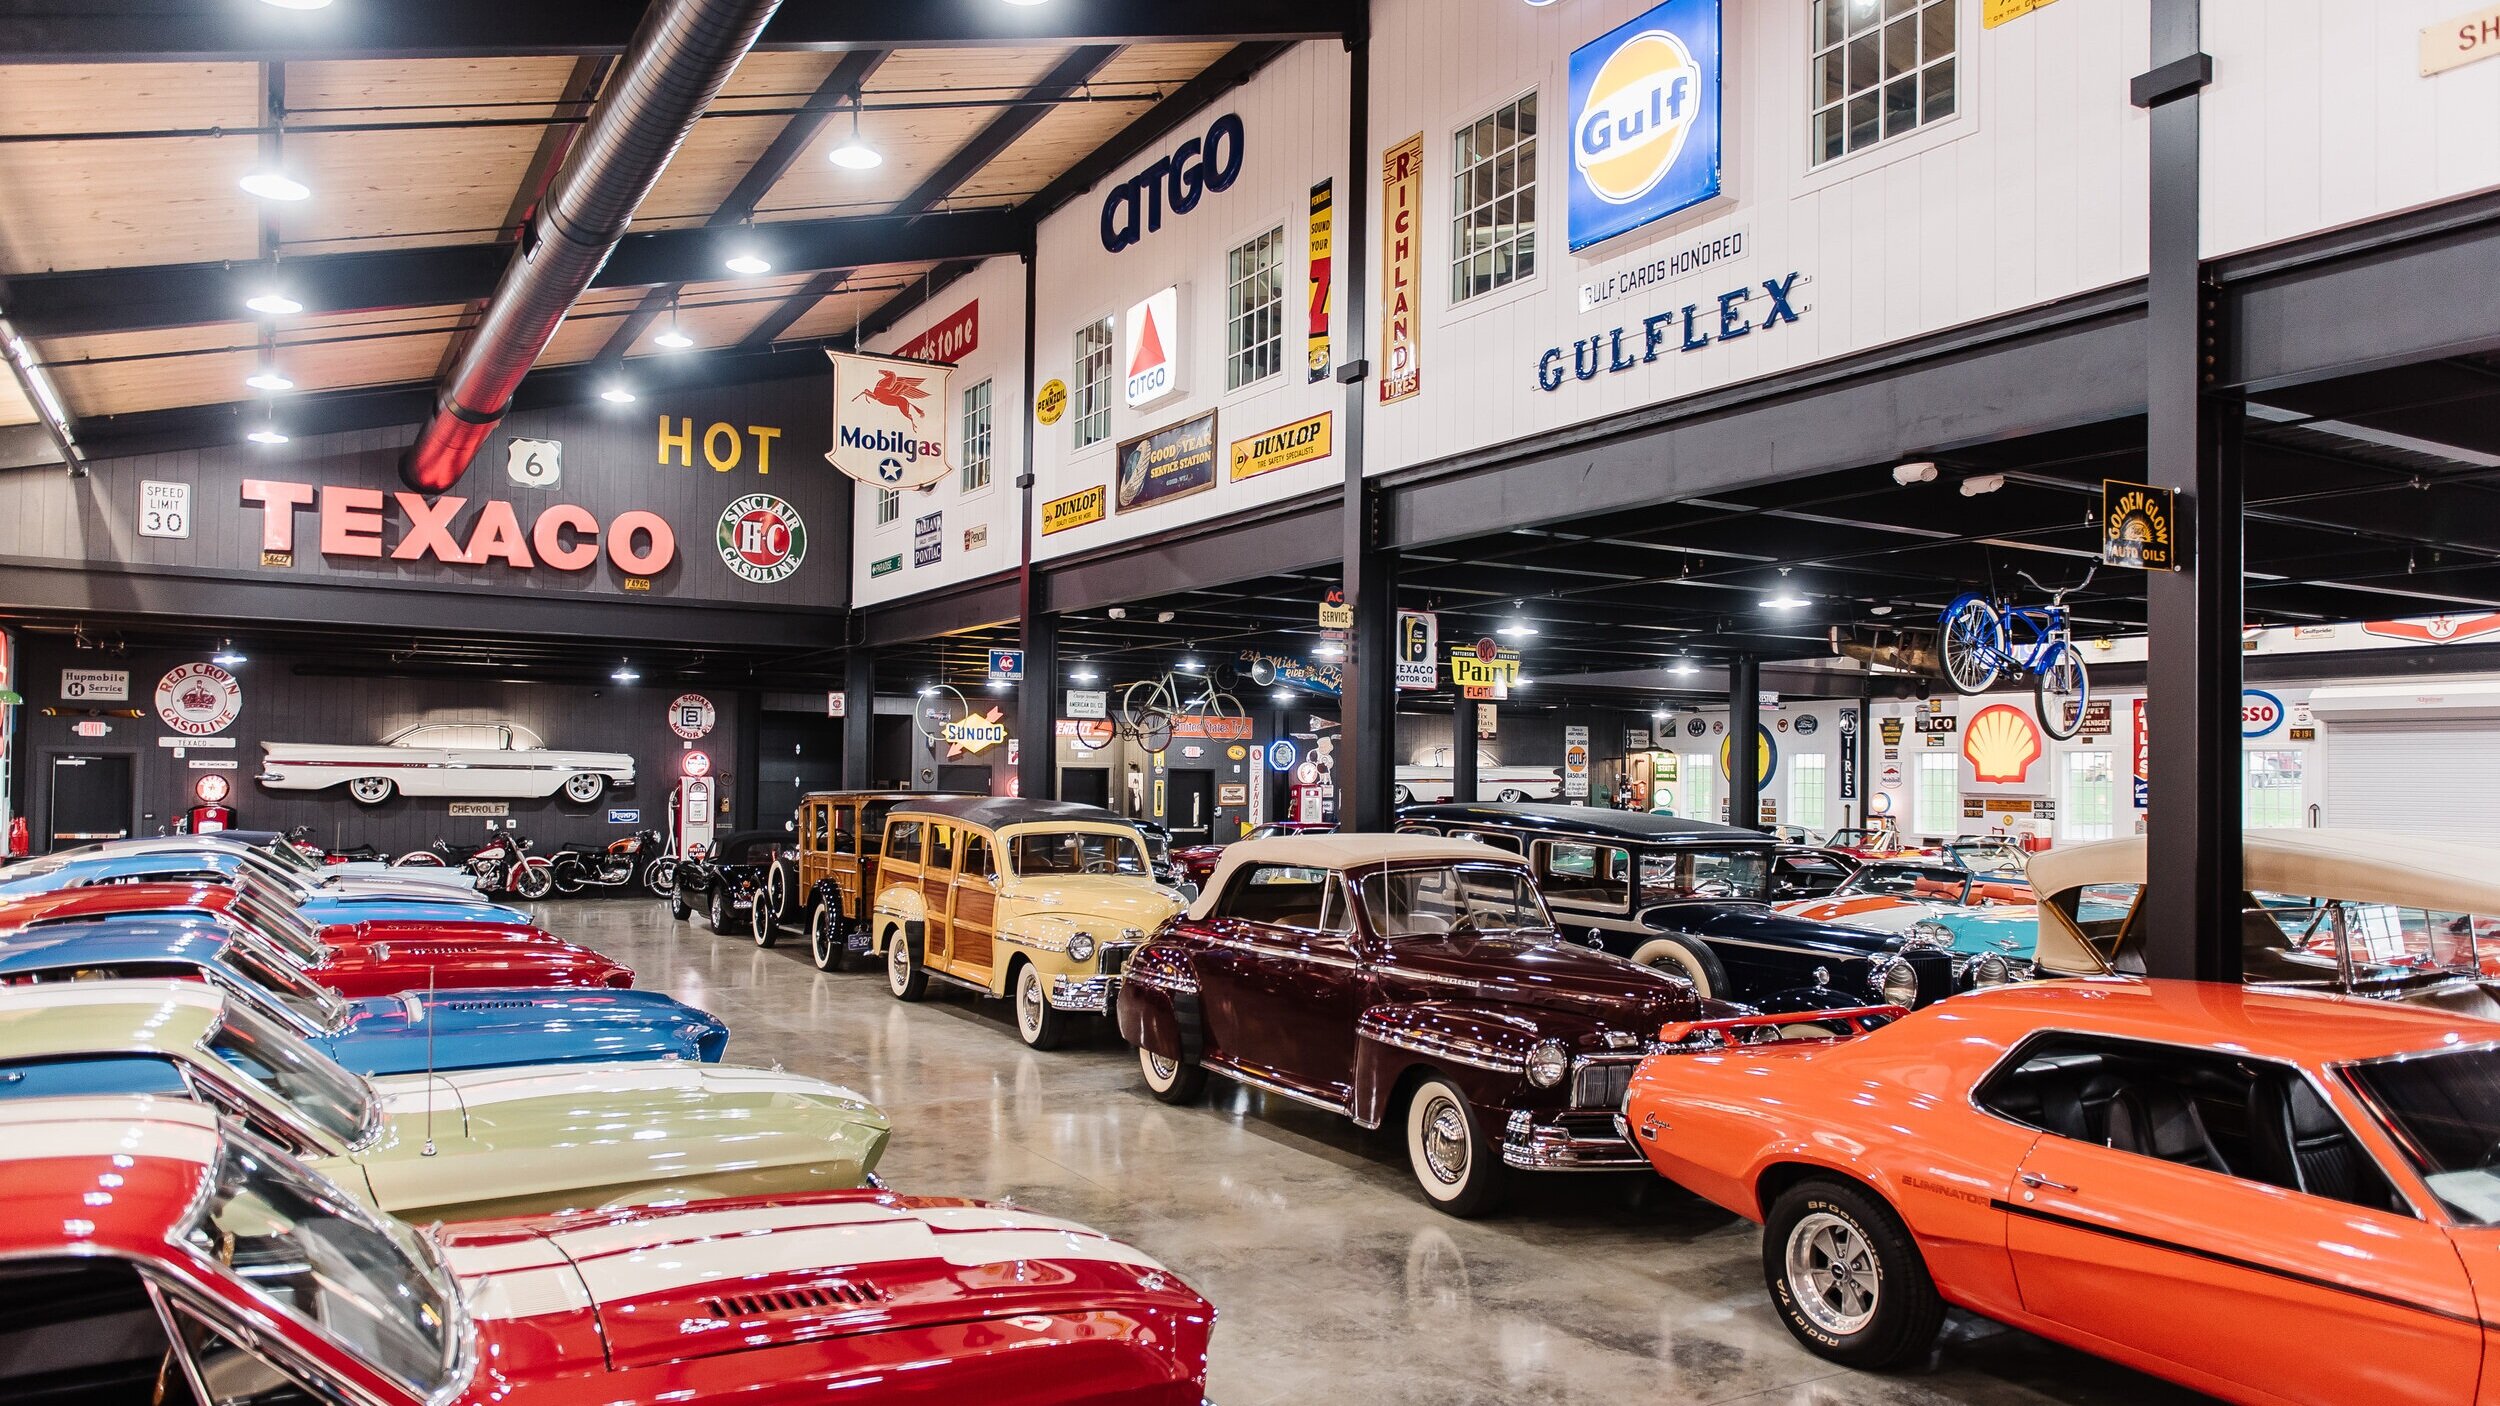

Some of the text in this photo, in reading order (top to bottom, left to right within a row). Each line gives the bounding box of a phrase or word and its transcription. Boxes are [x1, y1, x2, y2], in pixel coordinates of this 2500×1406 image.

[1581, 76, 1689, 156] Gulf
[1101, 113, 1244, 253] CITGO
[1311, 219, 1330, 234] SOUND
[1311, 238, 1328, 252] YOUR
[1393, 150, 1410, 371] RICHLAND
[1585, 233, 1743, 304] GULF CARDS HONORED
[1309, 257, 1331, 334] Z
[1538, 272, 1799, 392] GULFLEX
[1129, 367, 1165, 398] CITGO
[1383, 376, 1417, 399] TIRES
[1038, 389, 1066, 412] PENNZOIL
[658, 414, 781, 474] HOT
[841, 425, 942, 462] Mobilgas
[1252, 422, 1321, 459] DUNLOP
[1150, 445, 1176, 464] GOOD
[1150, 460, 1179, 478] SERVICE
[1179, 451, 1212, 470] STATION
[1257, 446, 1314, 468] TIRE SAFETY SPECIALISTS
[523, 453, 544, 478] 6
[147, 486, 184, 499] SPEED
[150, 500, 180, 510] LIMIT
[724, 496, 800, 532] SINCLAIR
[1055, 493, 1097, 518] DUNLOP
[147, 511, 182, 532] 30
[242, 479, 675, 575] TEXACO
[2108, 492, 2168, 544] GOLDEN GLOW
[915, 545, 941, 564] PONTIAC
[2112, 545, 2166, 561] AUTO OILS
[723, 554, 800, 581] GASOLINE
[1326, 591, 1343, 602] AC
[1322, 611, 1349, 623] SERVICE
[1000, 659, 1014, 668] AC
[1285, 668, 1305, 677] RIDES
[1397, 664, 1434, 674] EXACO
[1458, 660, 1515, 684] Paint
[66, 672, 125, 682] Hupmobile
[88, 683, 123, 692] Service
[159, 668, 187, 694] RED
[671, 695, 714, 714] BE SQUARE
[1759, 694, 1779, 703] ESTONE
[161, 707, 236, 734] GASOLINE
[686, 711, 698, 722] B
[2242, 706, 2273, 721] SSO
[83, 724, 103, 733] EXIT
[672, 722, 699, 738] MOTOR
[949, 724, 1001, 741] SUNOCO
[1056, 721, 1092, 735] ENDALL
[1175, 720, 1250, 733] United States Tires
[1568, 752, 1586, 764] GULF
[1844, 735, 1854, 797] TIRES
[451, 804, 507, 815] CHEVROLET
[1902, 1175, 1990, 1207] ELIMINATOR
[1776, 1279, 1840, 1347] Radial T/A
